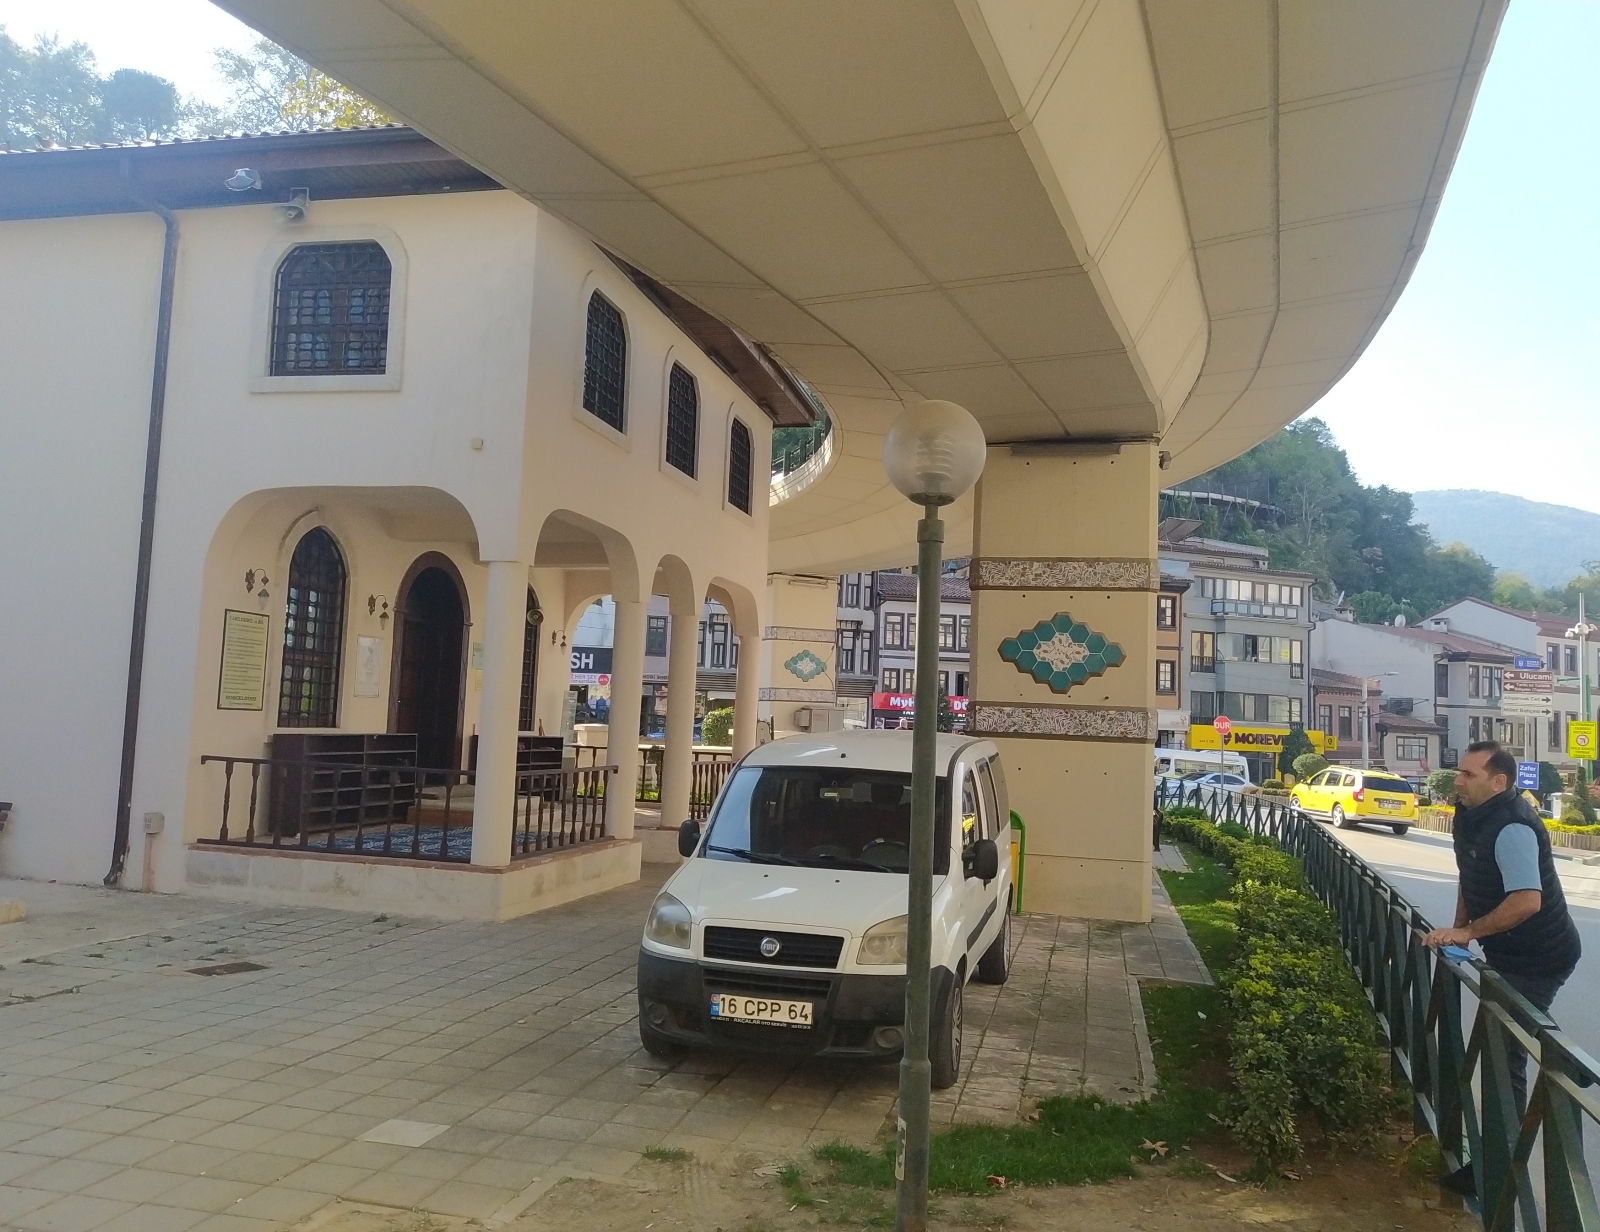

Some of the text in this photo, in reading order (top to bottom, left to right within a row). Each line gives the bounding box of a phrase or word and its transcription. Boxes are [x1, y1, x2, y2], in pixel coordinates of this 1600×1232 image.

[1519, 672, 1552, 681] Ulucami
[1214, 721, 1231, 729] DUR
[720, 997, 737, 1015] 16
[744, 999, 782, 1018] CPP
[788, 1003, 809, 1022] 64
[733, 1017, 761, 1025] AKÇALAR
